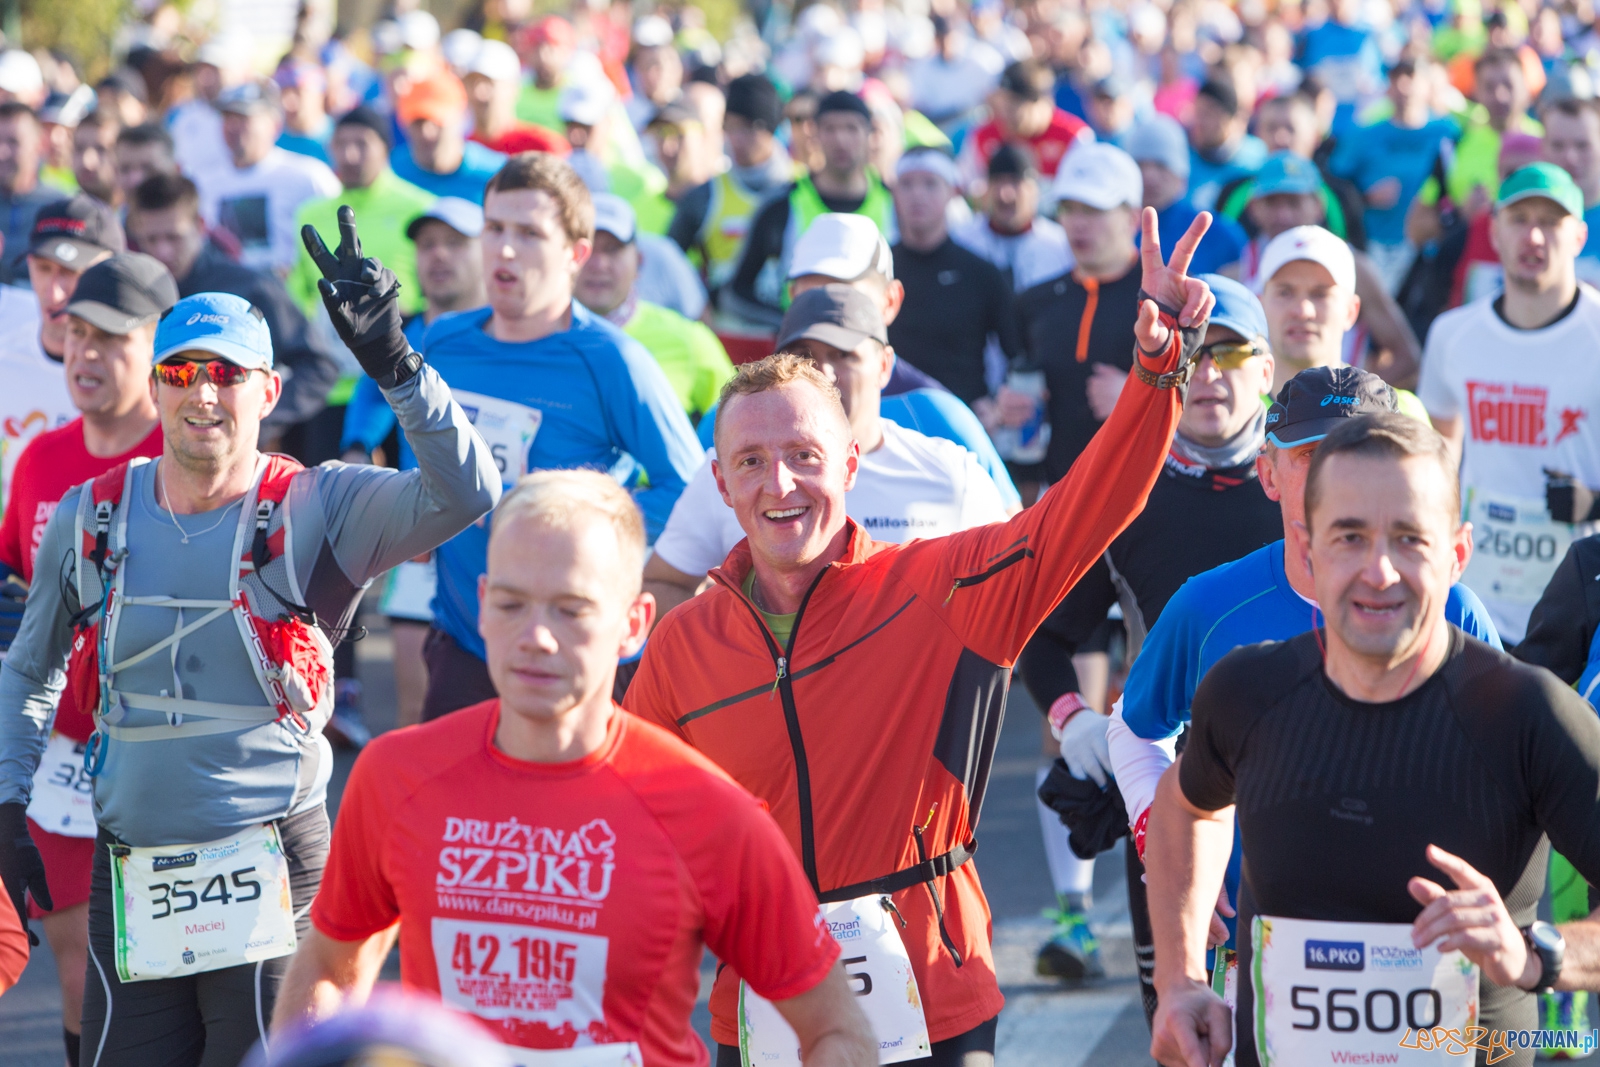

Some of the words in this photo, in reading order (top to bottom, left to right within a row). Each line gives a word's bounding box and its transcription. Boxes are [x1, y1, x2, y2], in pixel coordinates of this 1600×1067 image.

[200, 313, 230, 325] asics
[1334, 395, 1361, 406] asics
[1478, 524, 1556, 562] 2600
[48, 763, 93, 794] 38
[436, 846, 616, 901] SZPIKU
[148, 866, 262, 919] 3545
[185, 919, 226, 935] Maciej
[437, 894, 598, 930] www.darszpiku.pl
[831, 928, 861, 940] raton
[452, 931, 578, 986] 42,195
[841, 955, 873, 996] 5
[1291, 986, 1442, 1034] 5600
